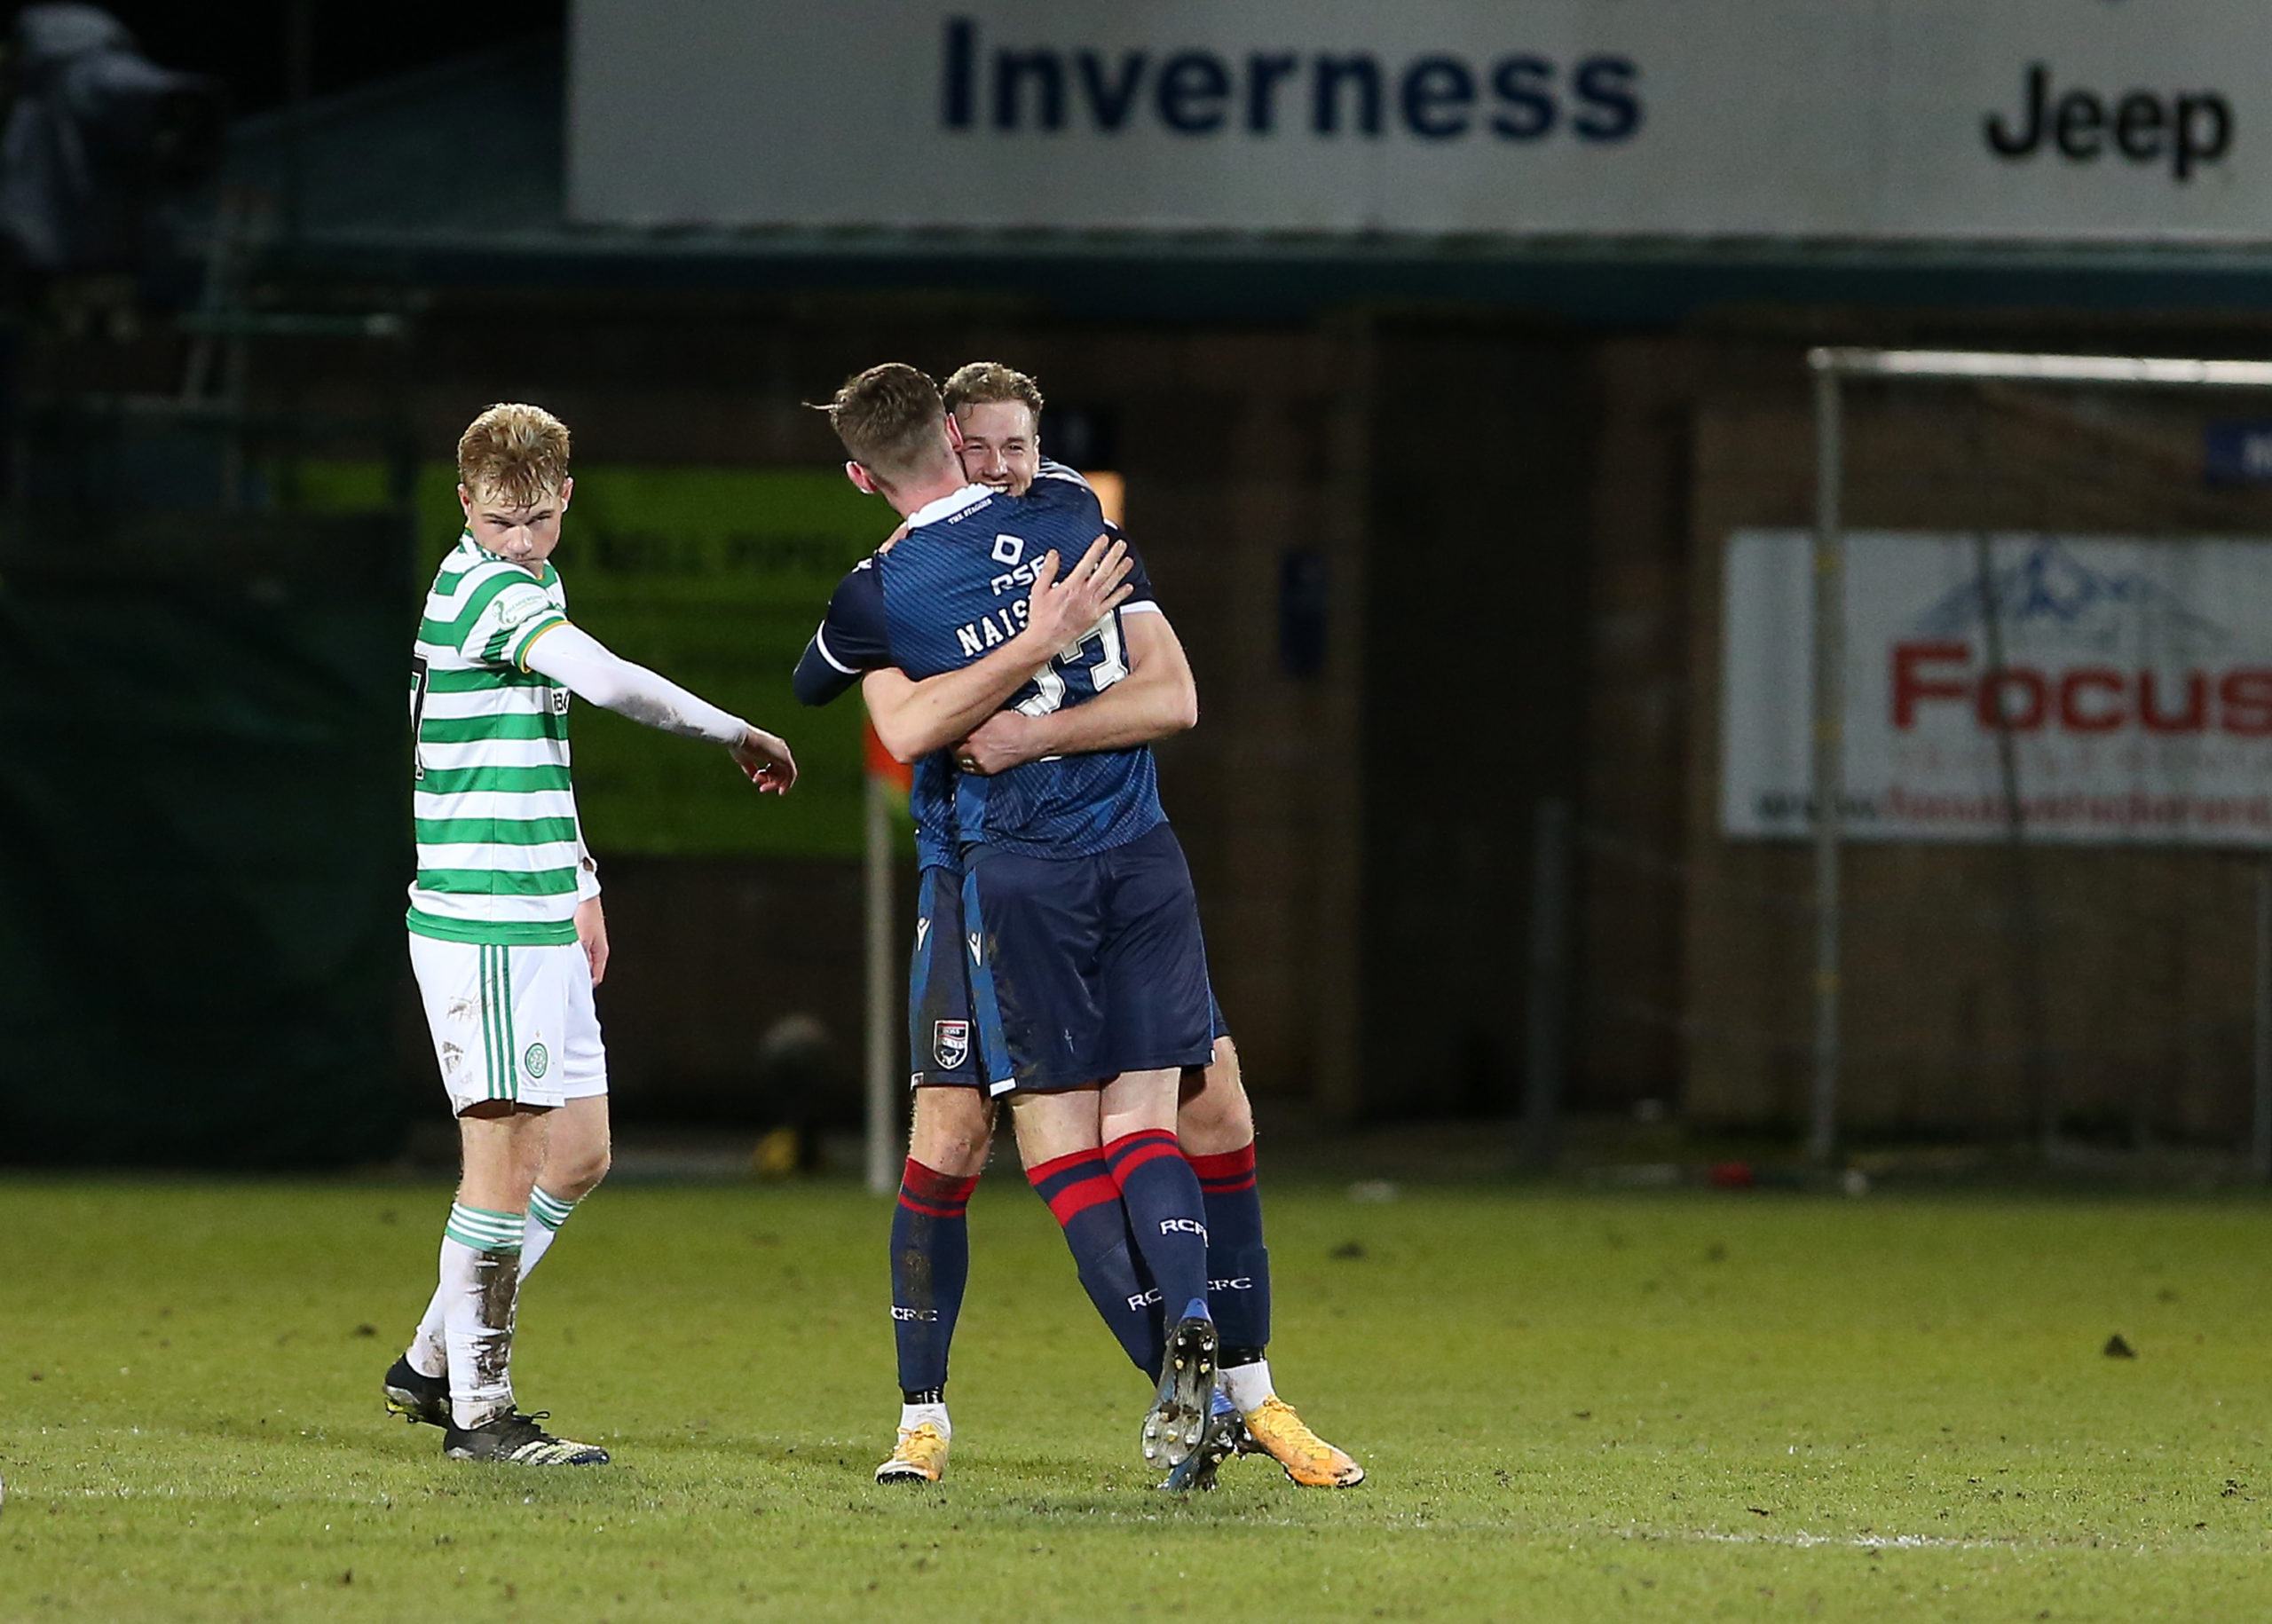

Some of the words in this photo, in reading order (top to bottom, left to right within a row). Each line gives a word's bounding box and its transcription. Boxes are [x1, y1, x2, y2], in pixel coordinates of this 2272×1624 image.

[941, 15, 1645, 142] Inverness
[1982, 60, 2235, 183] Jeep
[956, 597, 1030, 658] NAIS
[1890, 643, 2272, 737] Focus
[1127, 1288, 1163, 1312] RC
